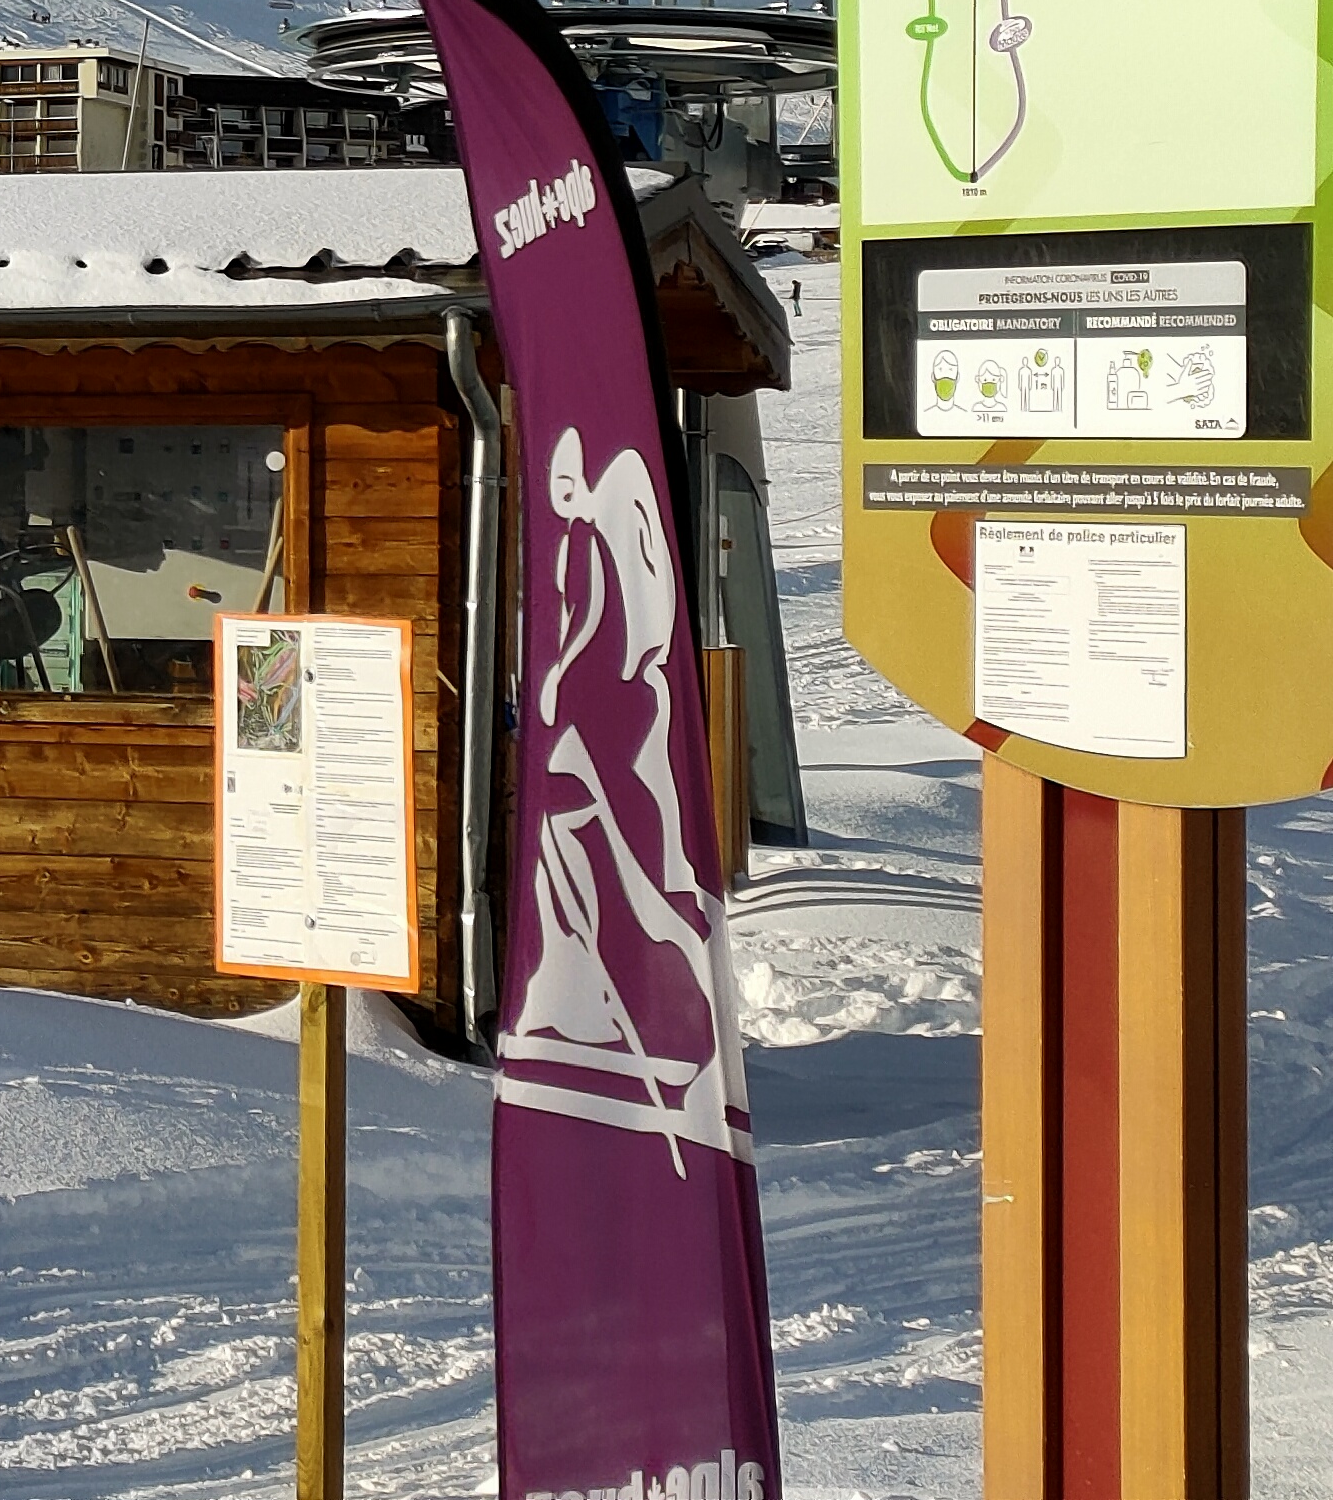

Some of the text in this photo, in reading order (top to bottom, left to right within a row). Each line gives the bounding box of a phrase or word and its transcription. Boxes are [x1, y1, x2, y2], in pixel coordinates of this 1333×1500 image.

[1112, 272, 1149, 283] COVID-19
[1086, 291, 1101, 303] LES
[1102, 290, 1124, 302] UNS
[1126, 289, 1141, 302] LES
[1142, 288, 1179, 302] AUTRES
[929, 312, 1237, 331] OBLIGATOIRE MANDATORY RECOMMANDÉ RECOMMENDED
[1194, 419, 1223, 431] SATA
[921, 469, 930, 483] de
[962, 472, 979, 483] vous
[1081, 470, 1091, 484] de
[1092, 472, 1129, 489] transport
[1142, 474, 1164, 485] cours
[1166, 471, 1176, 485] de
[1222, 475, 1236, 486] cas
[1237, 472, 1247, 486] de
[1185, 493, 1201, 511] prix
[1203, 493, 1214, 506] du
[1215, 493, 1240, 507] forfait
[1241, 493, 1274, 510] journée
[1048, 528, 1064, 542] de
[1067, 529, 1106, 545] police
[1109, 530, 1177, 546] particulier
